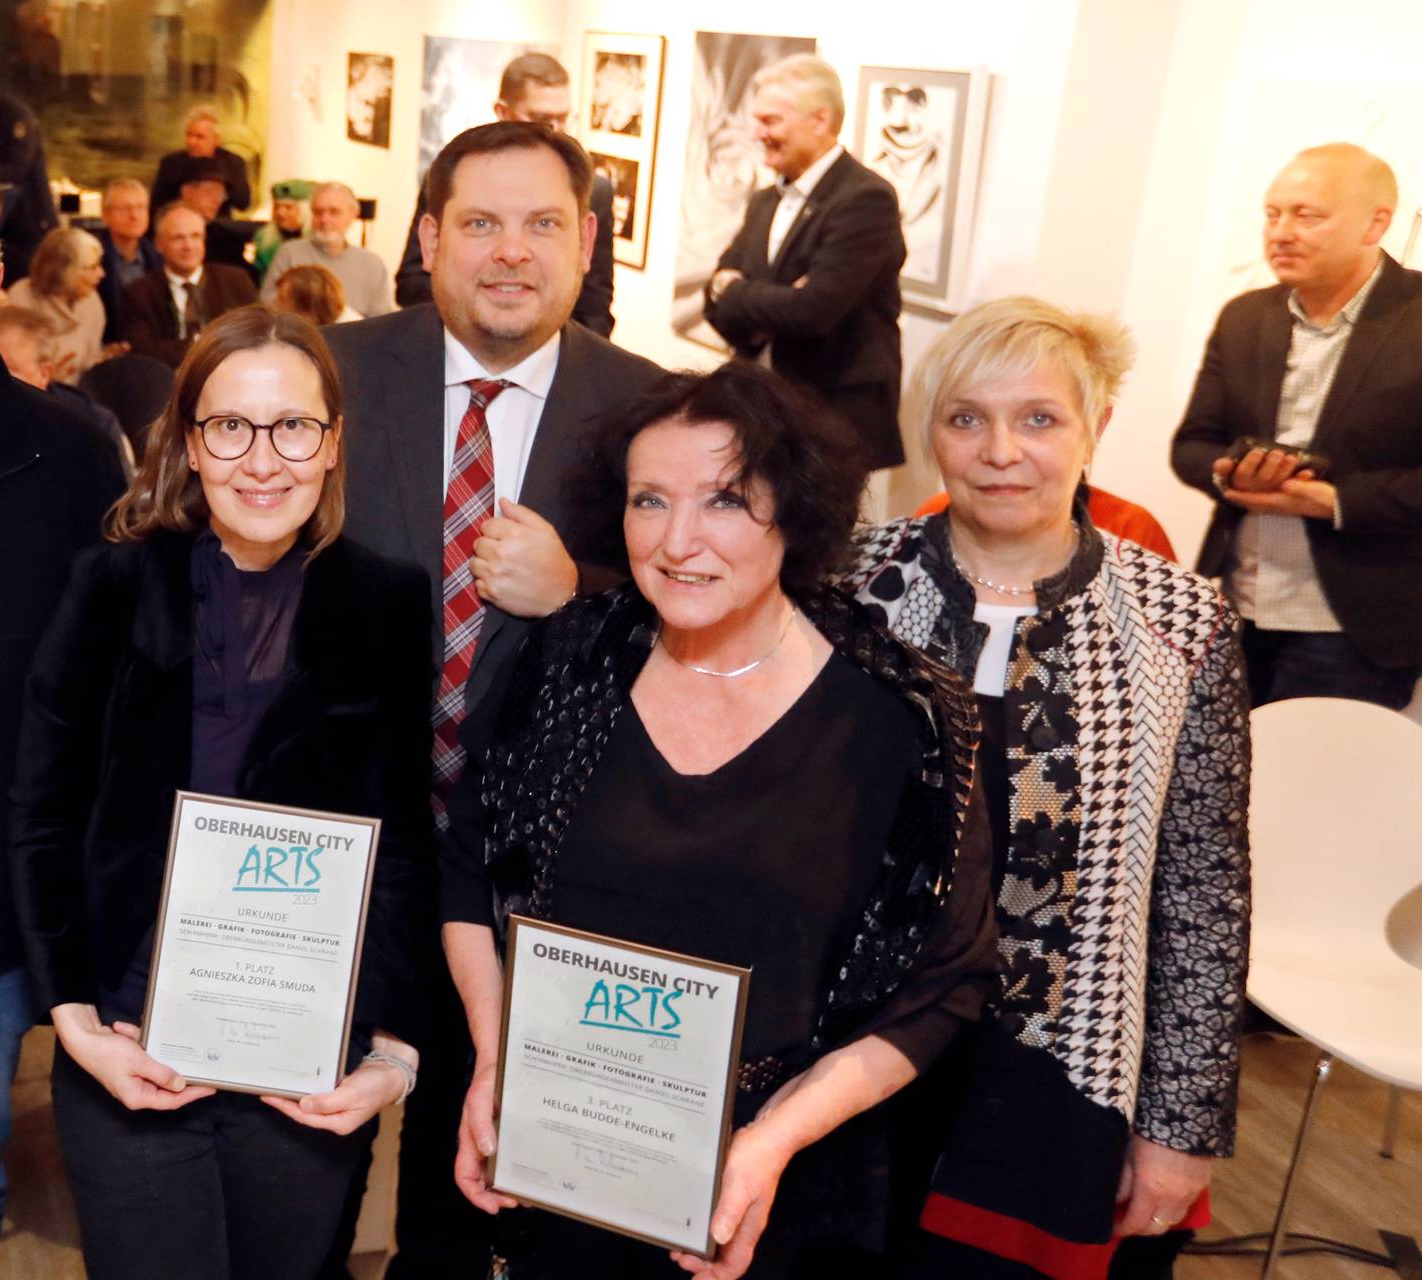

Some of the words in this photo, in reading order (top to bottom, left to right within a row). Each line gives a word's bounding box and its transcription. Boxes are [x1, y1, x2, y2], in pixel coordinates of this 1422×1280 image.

[194, 816, 312, 846] OBERHAUSEN
[316, 833, 354, 852] CITY
[232, 844, 324, 892] ARTS
[291, 894, 318, 906] 2023
[237, 907, 288, 922] URKUNDE
[180, 918, 212, 928] MALEREI
[218, 923, 245, 933] GRAFIK
[251, 928, 297, 940] FOTOGRAFIE
[302, 935, 340, 947] SKULPTUR
[190, 968, 245, 984] AGNIESZKA
[248, 975, 277, 988] ZOFIA
[279, 981, 315, 993] SMUDA
[235, 961, 241, 971] 1.
[246, 963, 274, 975] PLATZ
[532, 943, 668, 987] OBERHAUSEN
[673, 977, 719, 999] CITY
[579, 979, 683, 1038] ARTS
[586, 1042, 644, 1064] URKUNDE
[648, 1037, 679, 1051] 2023
[524, 1044, 560, 1057] MALEREI
[565, 1054, 597, 1068] GRAFIK
[602, 1064, 656, 1084] FOTOGRAFIE
[662, 1080, 707, 1098] SKULPTUR
[543, 1097, 579, 1116] HELGA
[582, 1109, 675, 1142] BUDDE-ENGELKE
[587, 1096, 595, 1106] 3.
[599, 1099, 634, 1116] PLATZ
